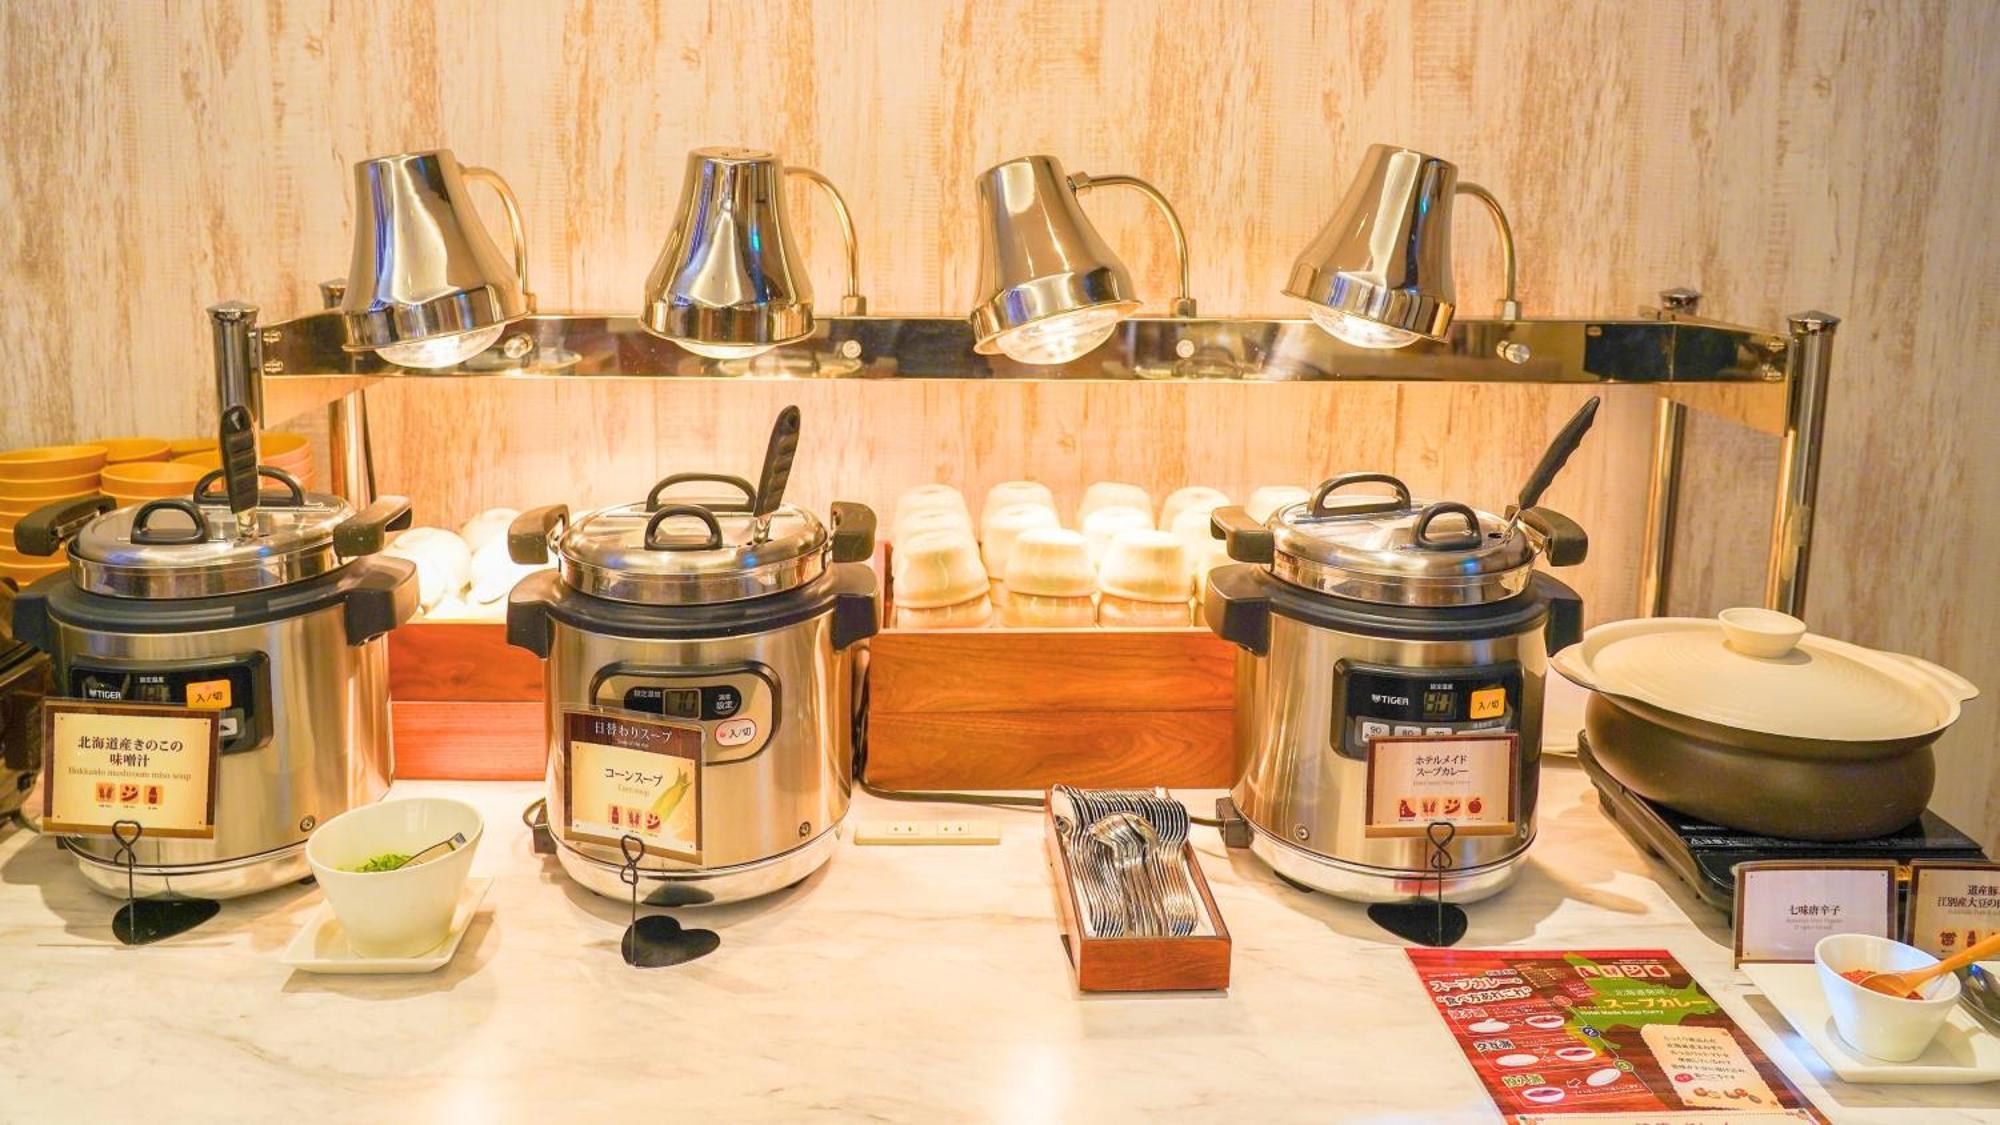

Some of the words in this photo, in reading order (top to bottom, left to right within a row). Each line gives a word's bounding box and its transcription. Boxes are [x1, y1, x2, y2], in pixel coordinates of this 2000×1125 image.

[97, 690, 121, 700] TIGER
[1382, 695, 1409, 705] TIGER
[595, 721, 673, 743] 日替わりスープ
[78, 735, 183, 753] 北海道産きのこの
[109, 752, 150, 768] 味噌汁
[1415, 754, 1468, 765] ホテルメイド
[604, 767, 663, 788] コーンスープ
[1415, 766, 1470, 777] スープカレー
[1968, 884, 2000, 896] 道産豚
[1788, 904, 1841, 916] 七味唐辛子
[1604, 998, 1708, 1009] スープカレー
